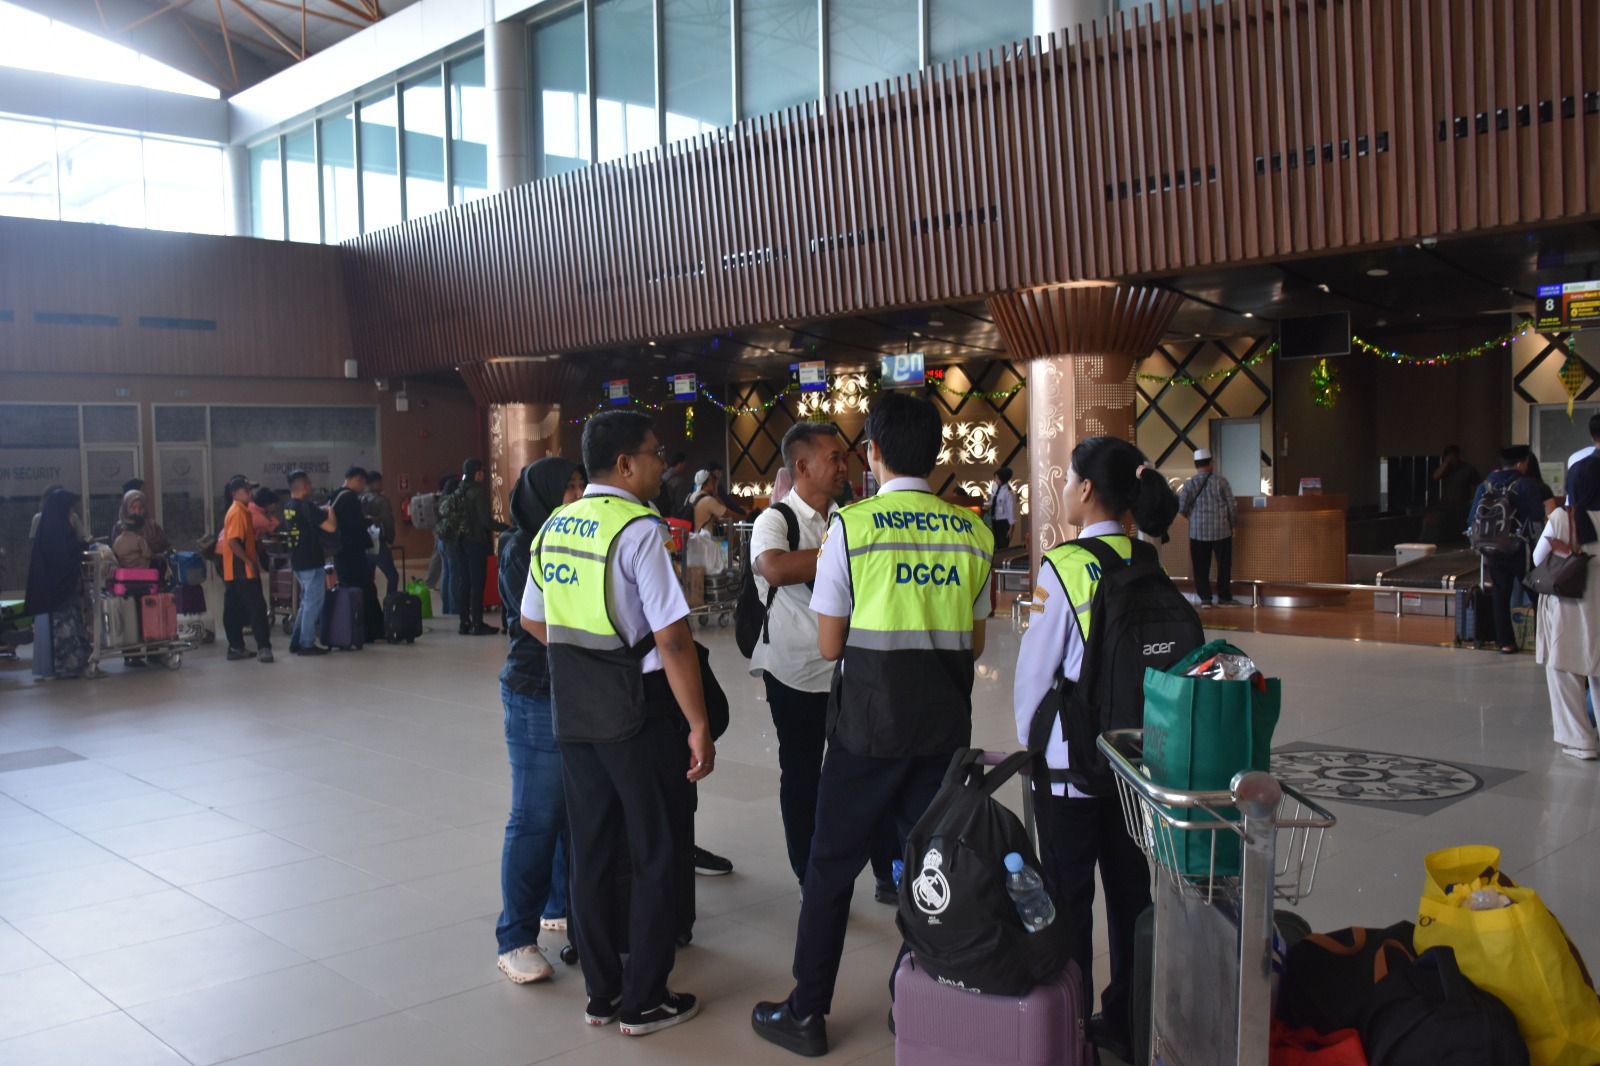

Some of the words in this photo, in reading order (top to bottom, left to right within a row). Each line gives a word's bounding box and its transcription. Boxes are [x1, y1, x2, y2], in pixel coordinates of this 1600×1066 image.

[1545, 298, 1554, 311] 8
[13, 466, 61, 480] SECURITY
[263, 462, 296, 474] AIRPORT
[299, 462, 331, 474] SERVICE
[872, 511, 974, 535] INSPECTOR
[896, 562, 961, 587] DGCA
[1142, 641, 1175, 655] acer
